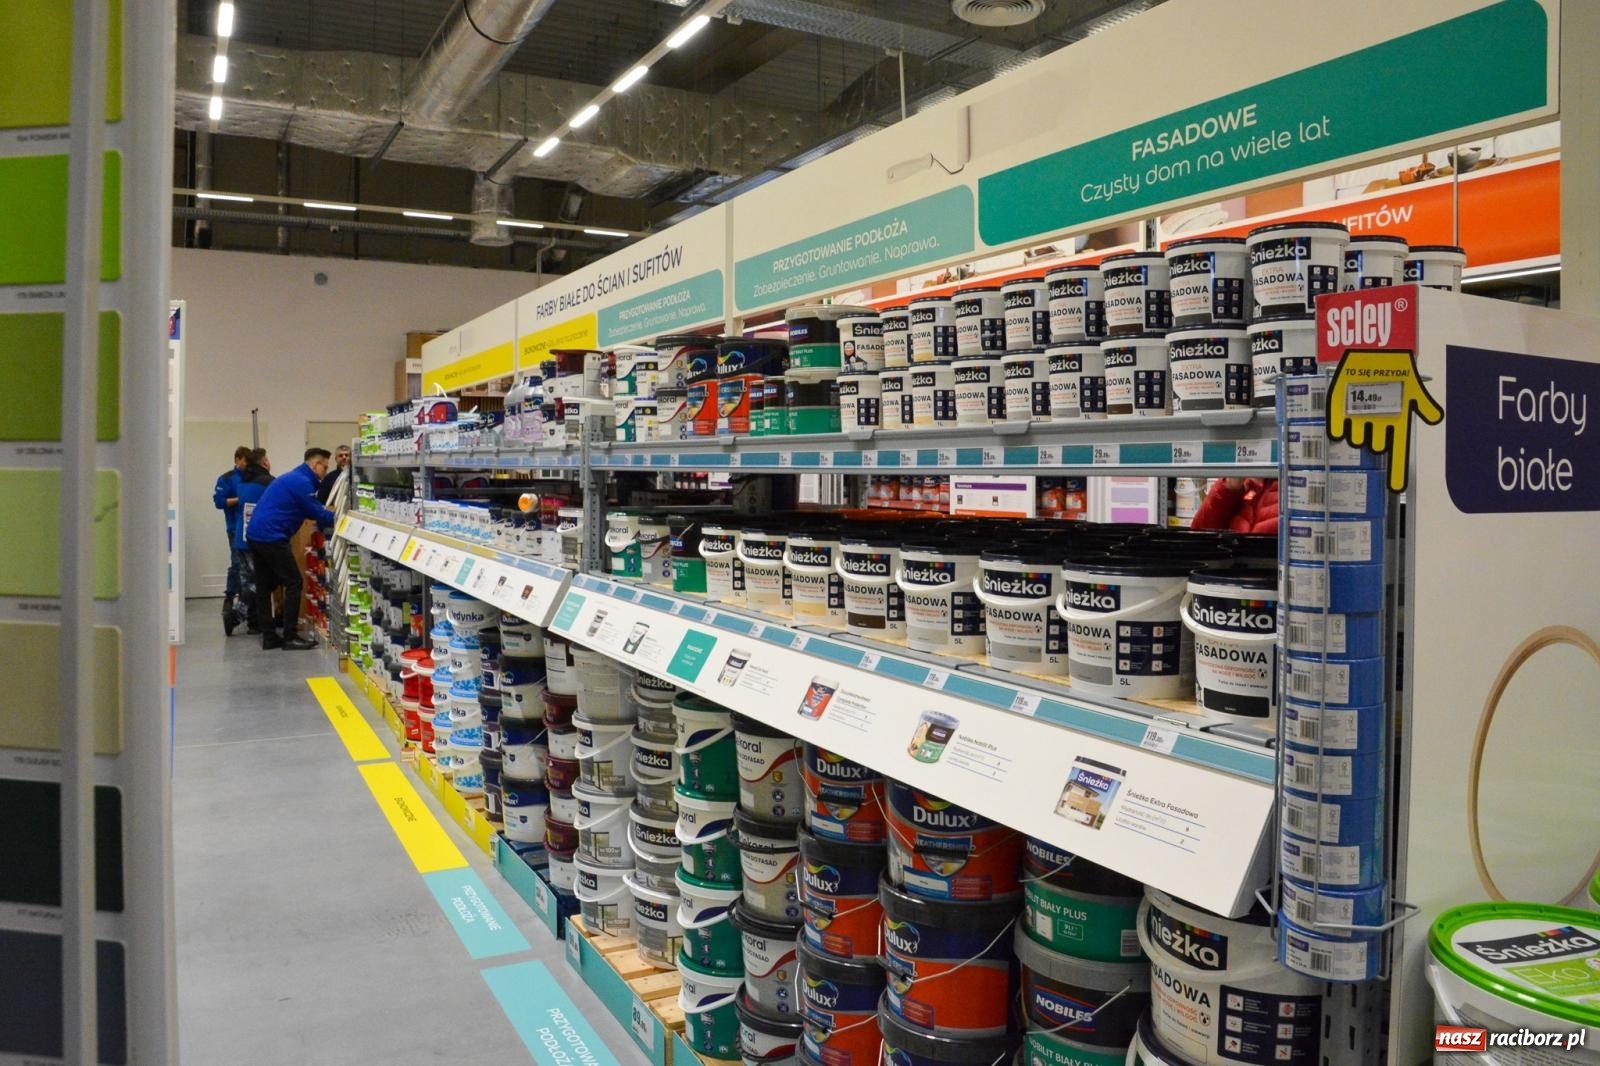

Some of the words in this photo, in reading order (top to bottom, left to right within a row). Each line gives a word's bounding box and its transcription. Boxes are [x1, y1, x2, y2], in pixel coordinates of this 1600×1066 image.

[1132, 104, 1257, 161] FASADOWE
[1080, 169, 1140, 205] Czysty
[1145, 157, 1192, 186] dom
[1197, 149, 1225, 170] na
[1230, 129, 1291, 163] wiele
[1299, 115, 1330, 146] lat
[773, 237, 853, 273] PRZYGOTOWANIE
[855, 217, 909, 249] PODŁOŻA
[1251, 242, 1307, 264] Śnieżka
[536, 296, 557, 321] FARBY
[559, 290, 581, 314] BIAŁE
[582, 284, 596, 303] DO
[597, 274, 625, 298] ŚCIAN
[633, 245, 683, 284] SUFITÓW
[1327, 300, 1392, 348] scley
[1170, 342, 1225, 359] Śnieżka
[1358, 369, 1370, 378] SIĘ
[1373, 369, 1410, 377] PRZYDA!
[1499, 375, 1587, 443] Farby
[1499, 446, 1573, 492] białe
[984, 575, 1047, 596] Śnieżka
[1193, 600, 1273, 629] Śnieżka
[1049, 656, 1059, 664] 5L
[1119, 677, 1131, 687] 5L
[817, 758, 861, 779] Dulux
[1078, 772, 1109, 791] Śnieżka
[913, 805, 973, 829] Dulux
[1026, 840, 1071, 866] NOBILES
[1063, 908, 1088, 922] PLUS
[1475, 936, 1591, 961] Śnieżka
[1035, 993, 1093, 1022] NOBILES
